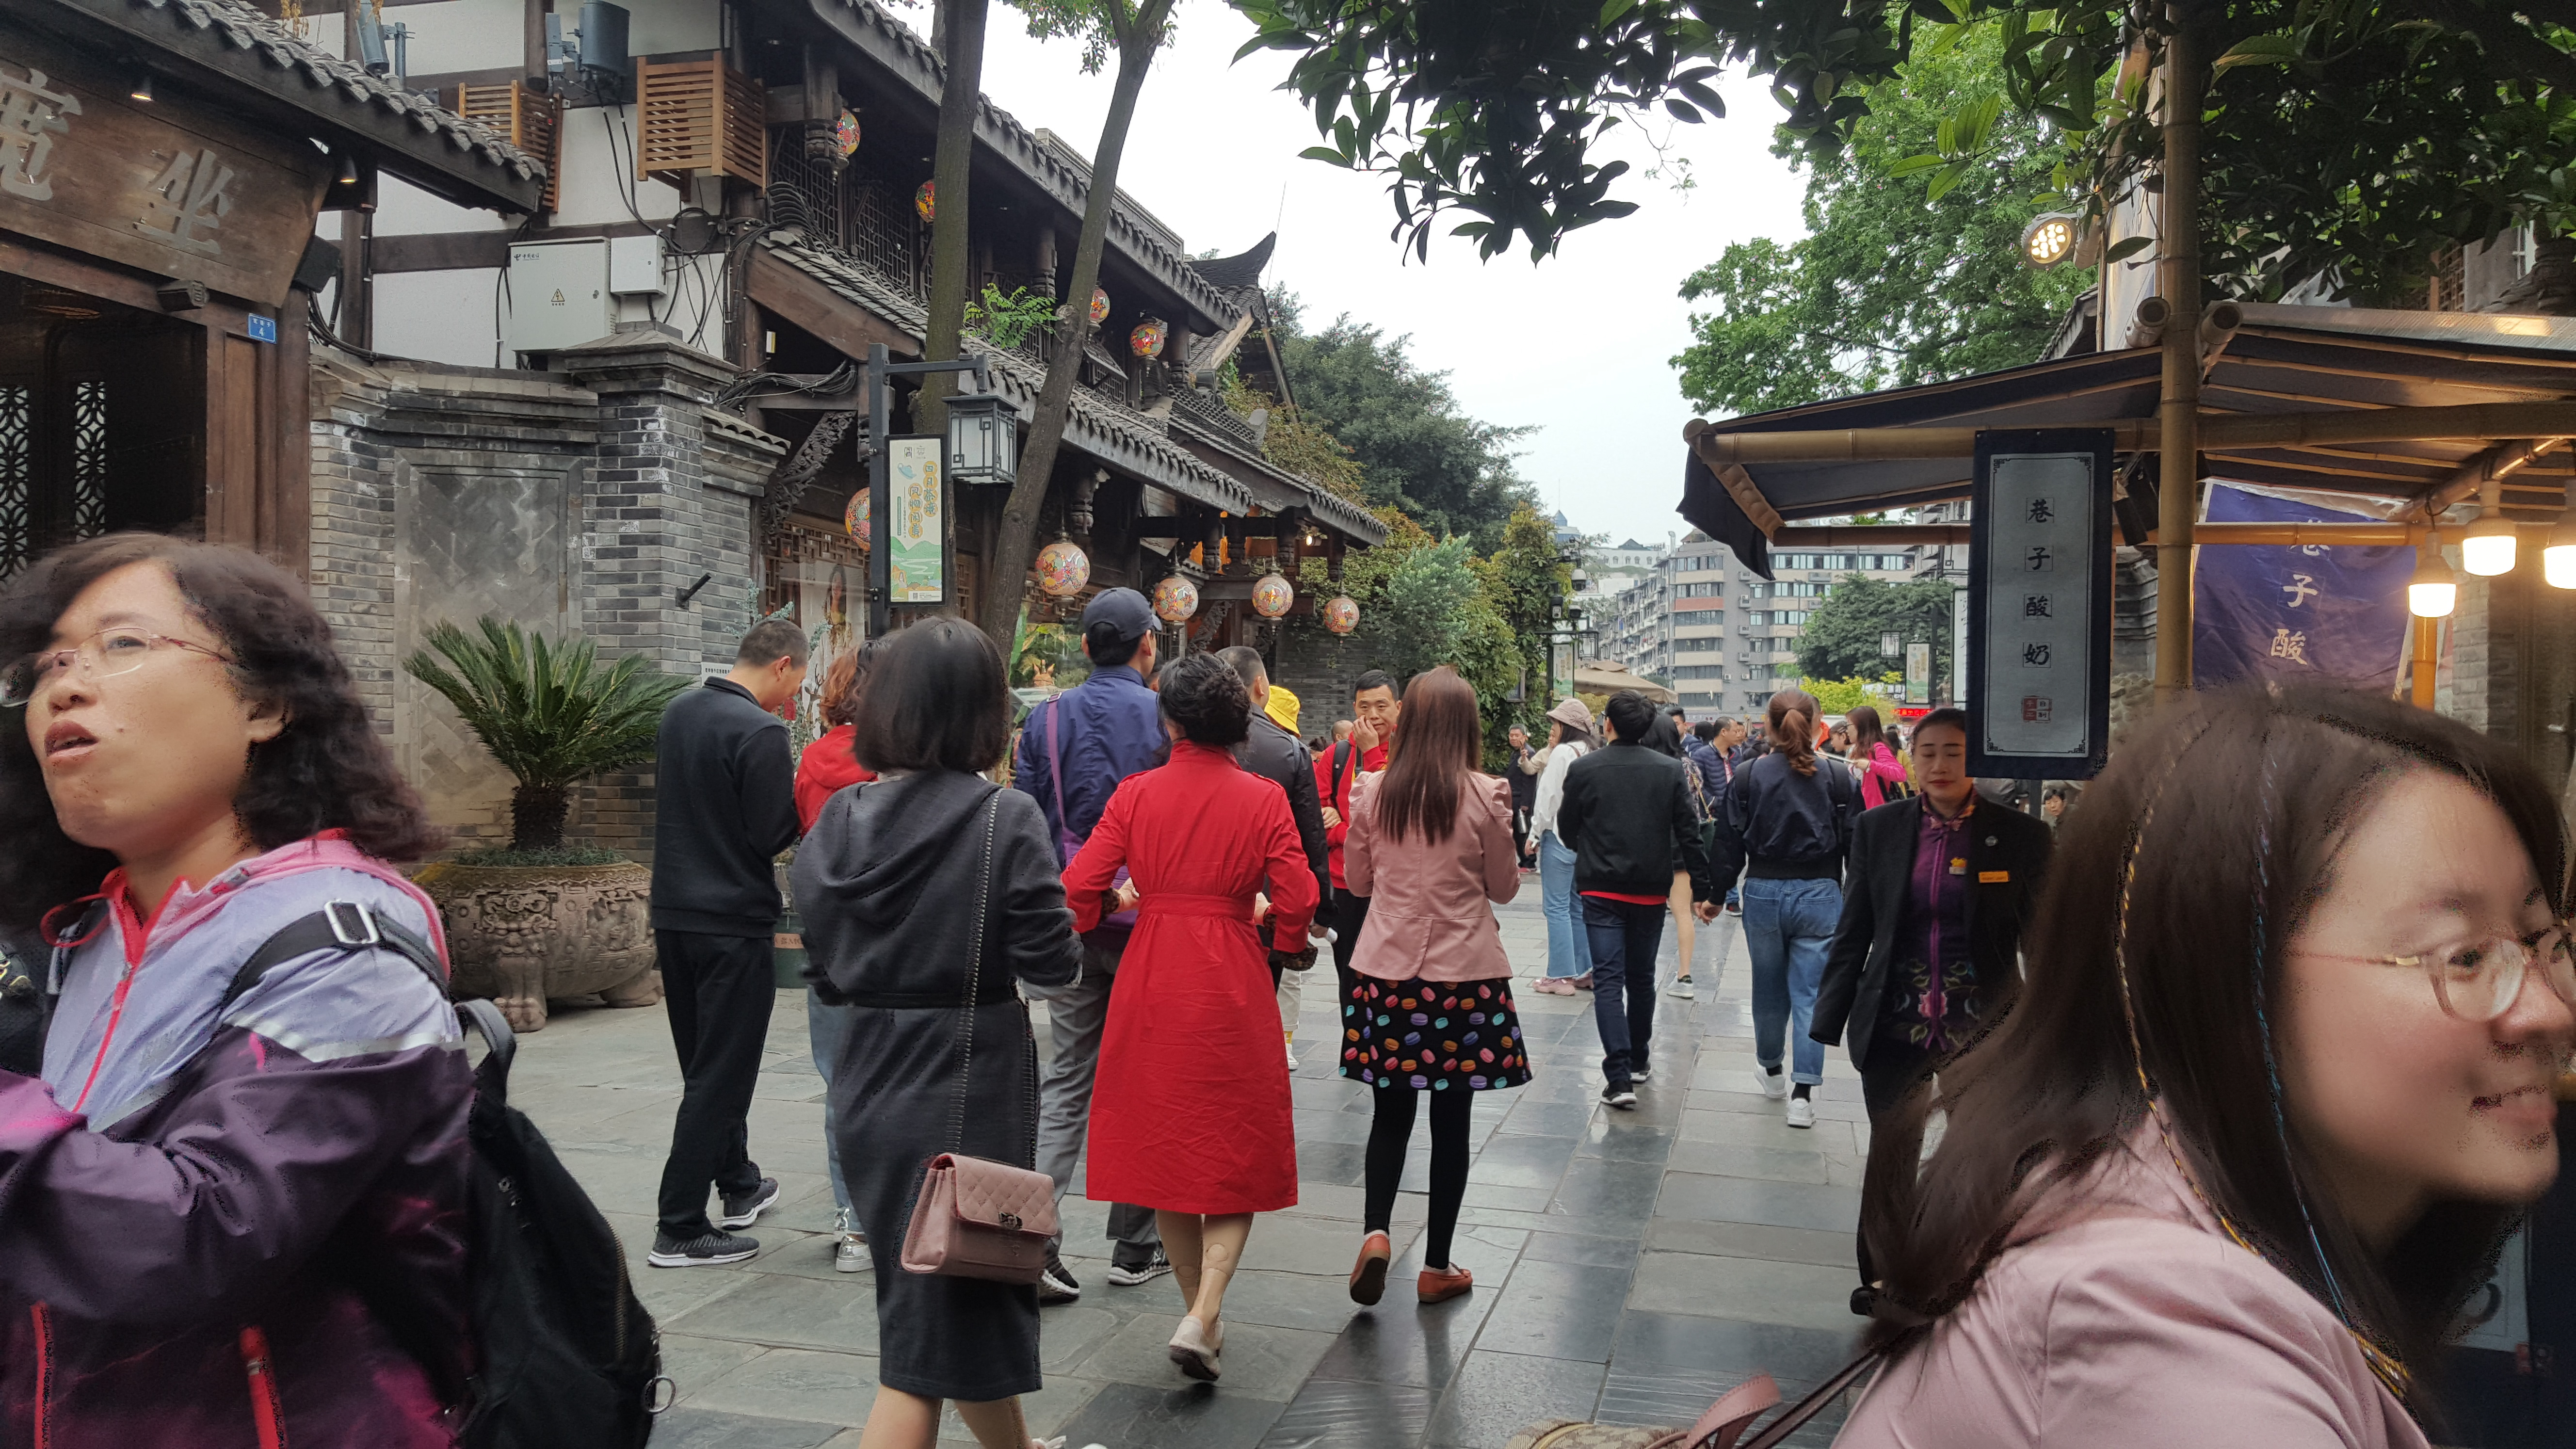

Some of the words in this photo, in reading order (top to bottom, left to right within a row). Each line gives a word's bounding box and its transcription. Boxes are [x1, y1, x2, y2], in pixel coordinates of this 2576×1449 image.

[259, 327, 264, 337] 4
[2023, 499, 2054, 665] 巷子酸奶
